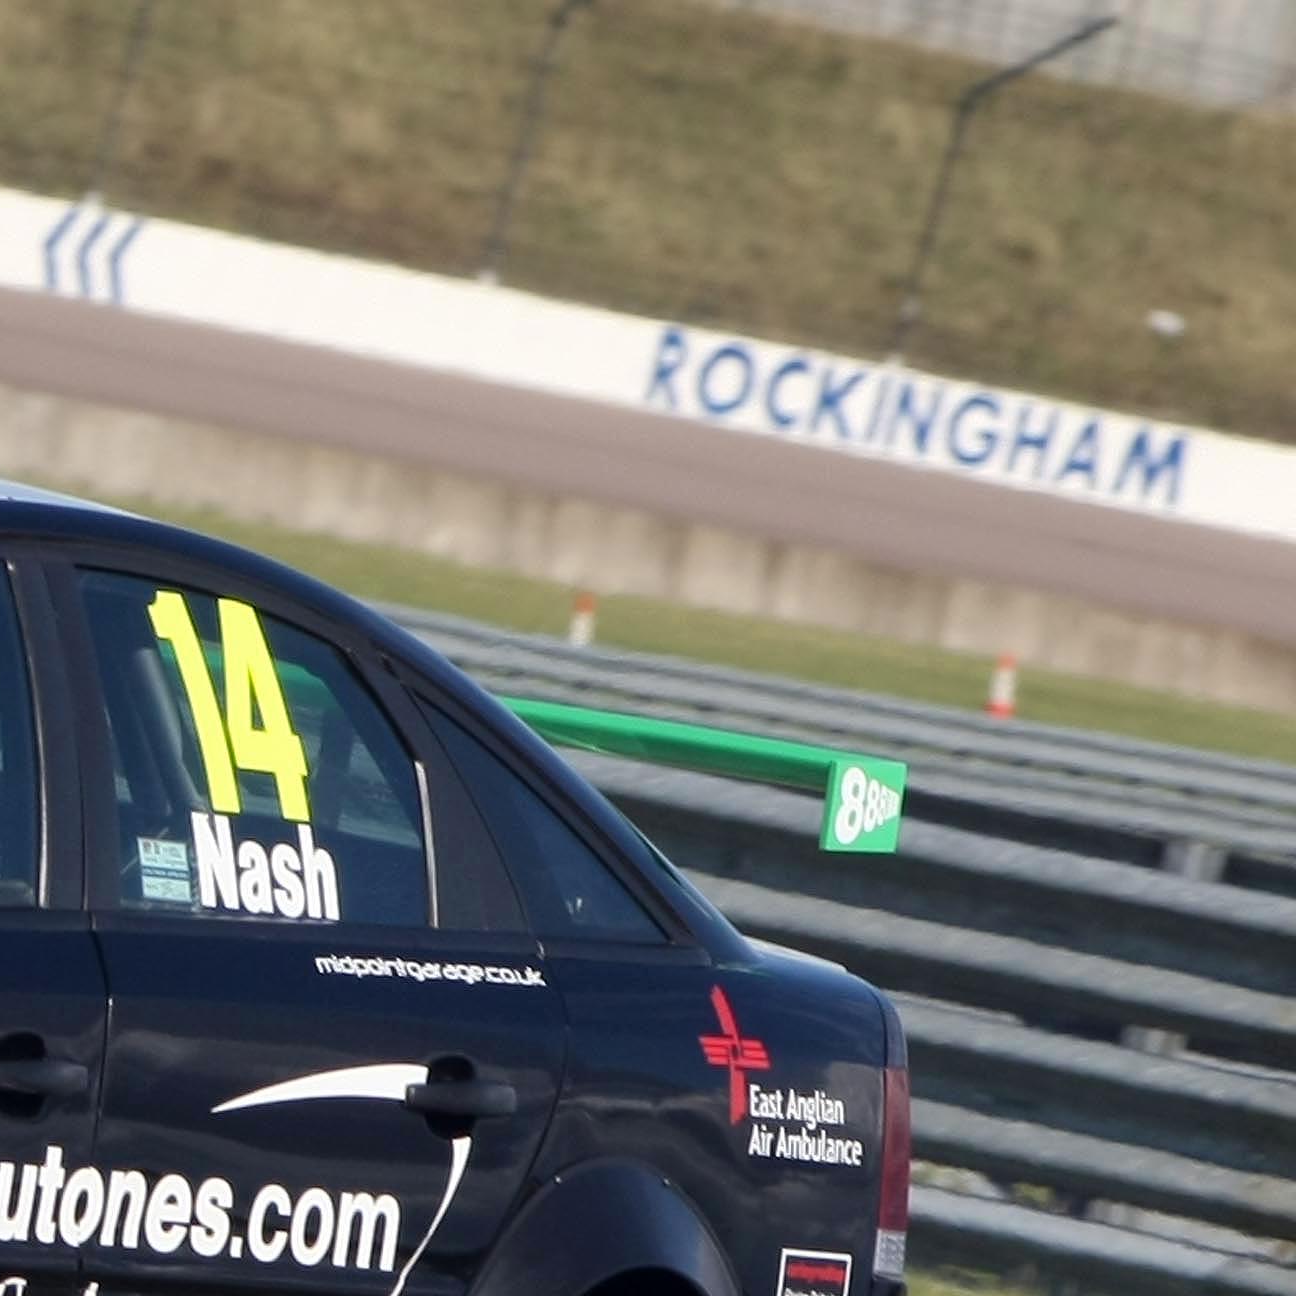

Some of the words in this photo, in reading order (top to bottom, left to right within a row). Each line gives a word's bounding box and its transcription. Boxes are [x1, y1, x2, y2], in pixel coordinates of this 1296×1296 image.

[646, 328, 1188, 508] ROCKINGHAM
[147, 589, 313, 822] 14
[190, 811, 342, 922] Nash
[314, 954, 547, 987] midpointgarage.co.uk
[748, 1123, 775, 1157] Air
[775, 1126, 864, 1167] Ambulance
[749, 1083, 785, 1120] East
[786, 1088, 845, 1130] Anglian
